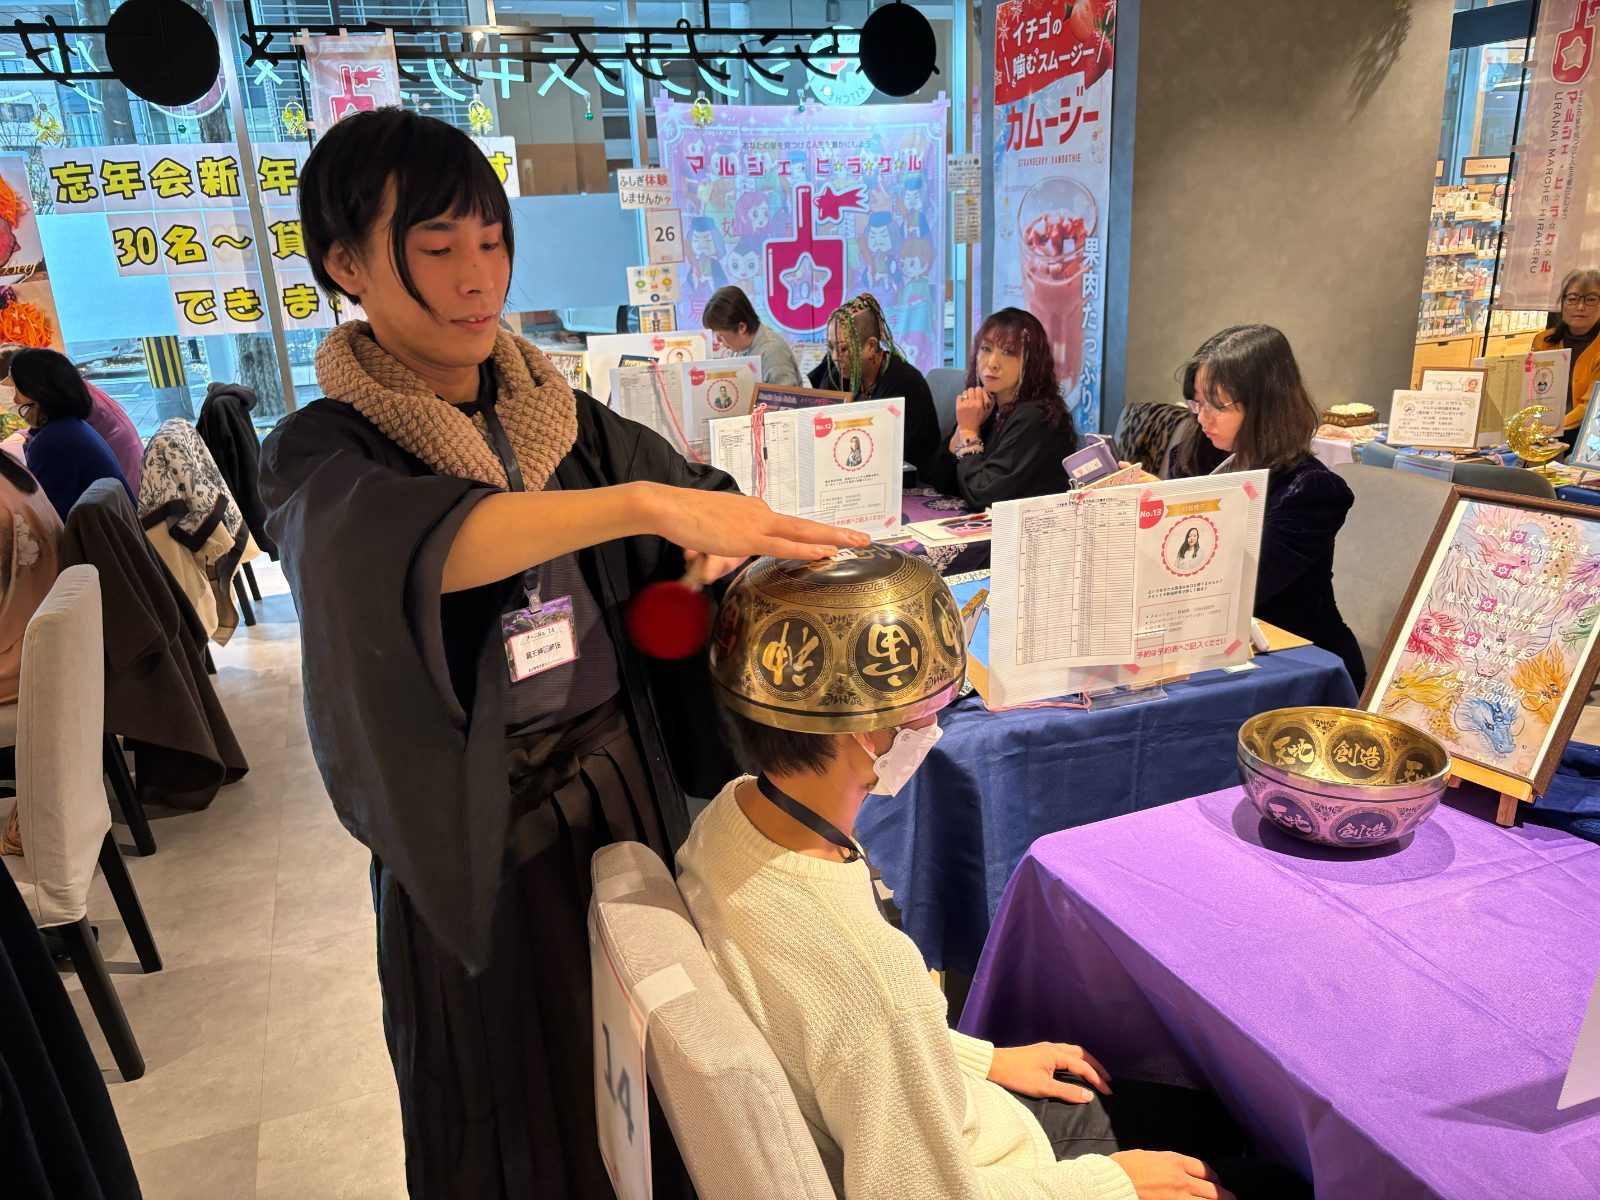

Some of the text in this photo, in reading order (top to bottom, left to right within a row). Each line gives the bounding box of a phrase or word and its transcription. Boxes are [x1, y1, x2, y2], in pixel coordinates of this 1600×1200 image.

[1012, 11, 1062, 47] イチゴの
[1006, 86, 1099, 152] カムージー
[620, 174, 668, 188] ふしぎ体験
[1530, 91, 1563, 274] URANAI MARCHE HIRAKERU
[655, 226, 675, 242] 26
[1140, 508, 1162, 518] No.13
[1136, 638, 1227, 660] 予約は予約表へご記入ください
[1333, 739, 1381, 771] 創造
[1337, 821, 1388, 841] 創造
